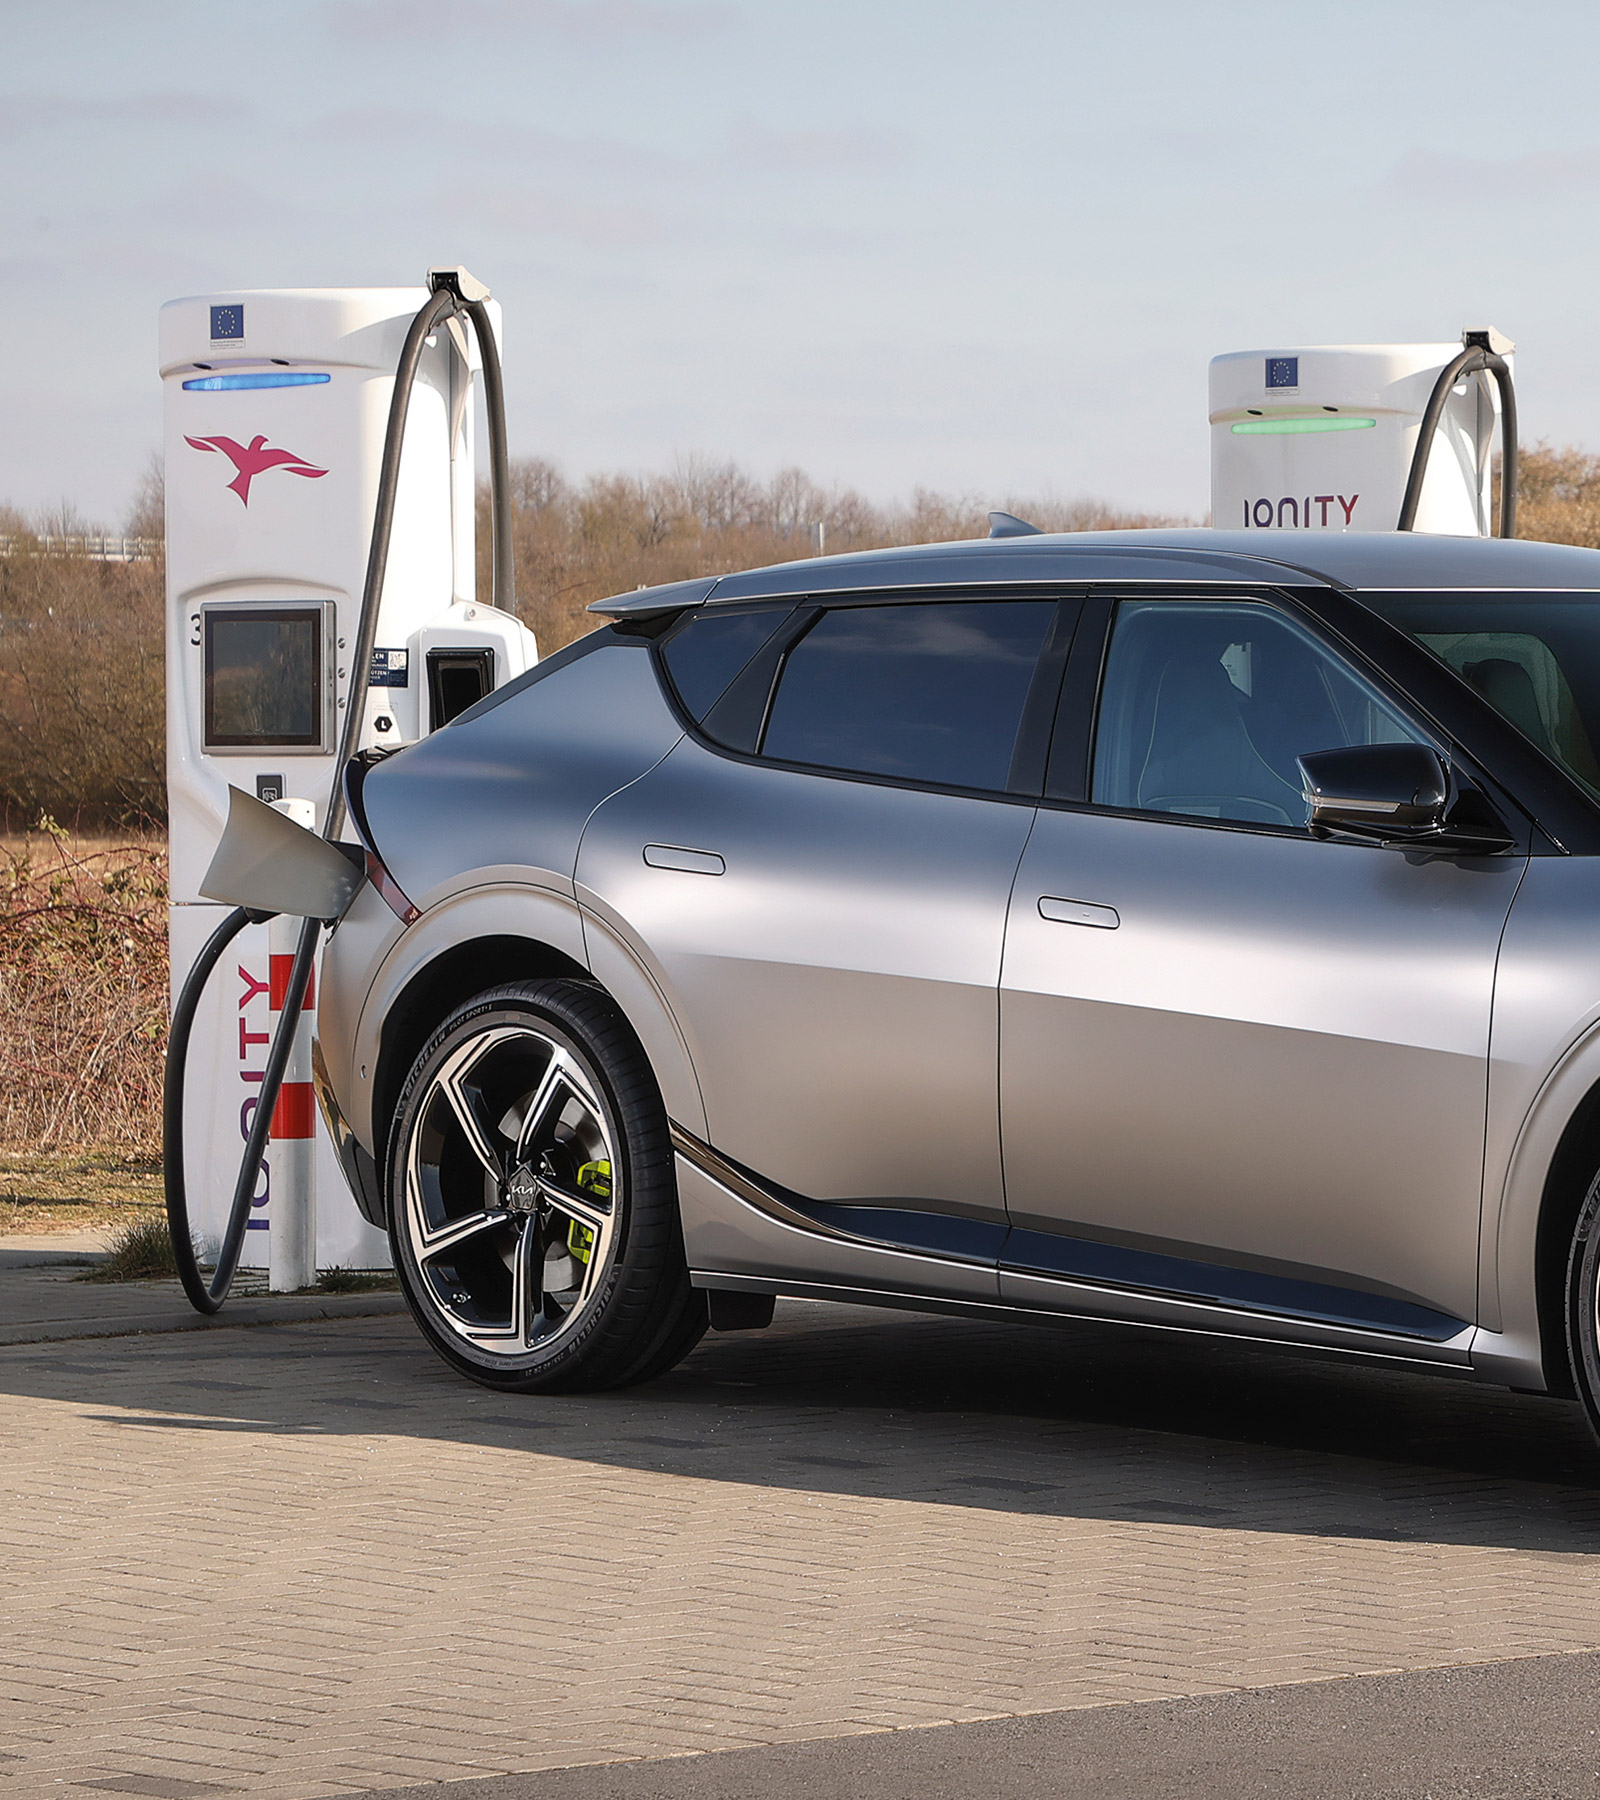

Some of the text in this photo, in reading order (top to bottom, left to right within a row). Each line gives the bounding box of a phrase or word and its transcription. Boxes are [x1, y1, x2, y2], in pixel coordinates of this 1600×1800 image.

[1244, 494, 1359, 528] IONITY
[190, 613, 201, 646] 3
[405, 1031, 446, 1097] MICHELIN
